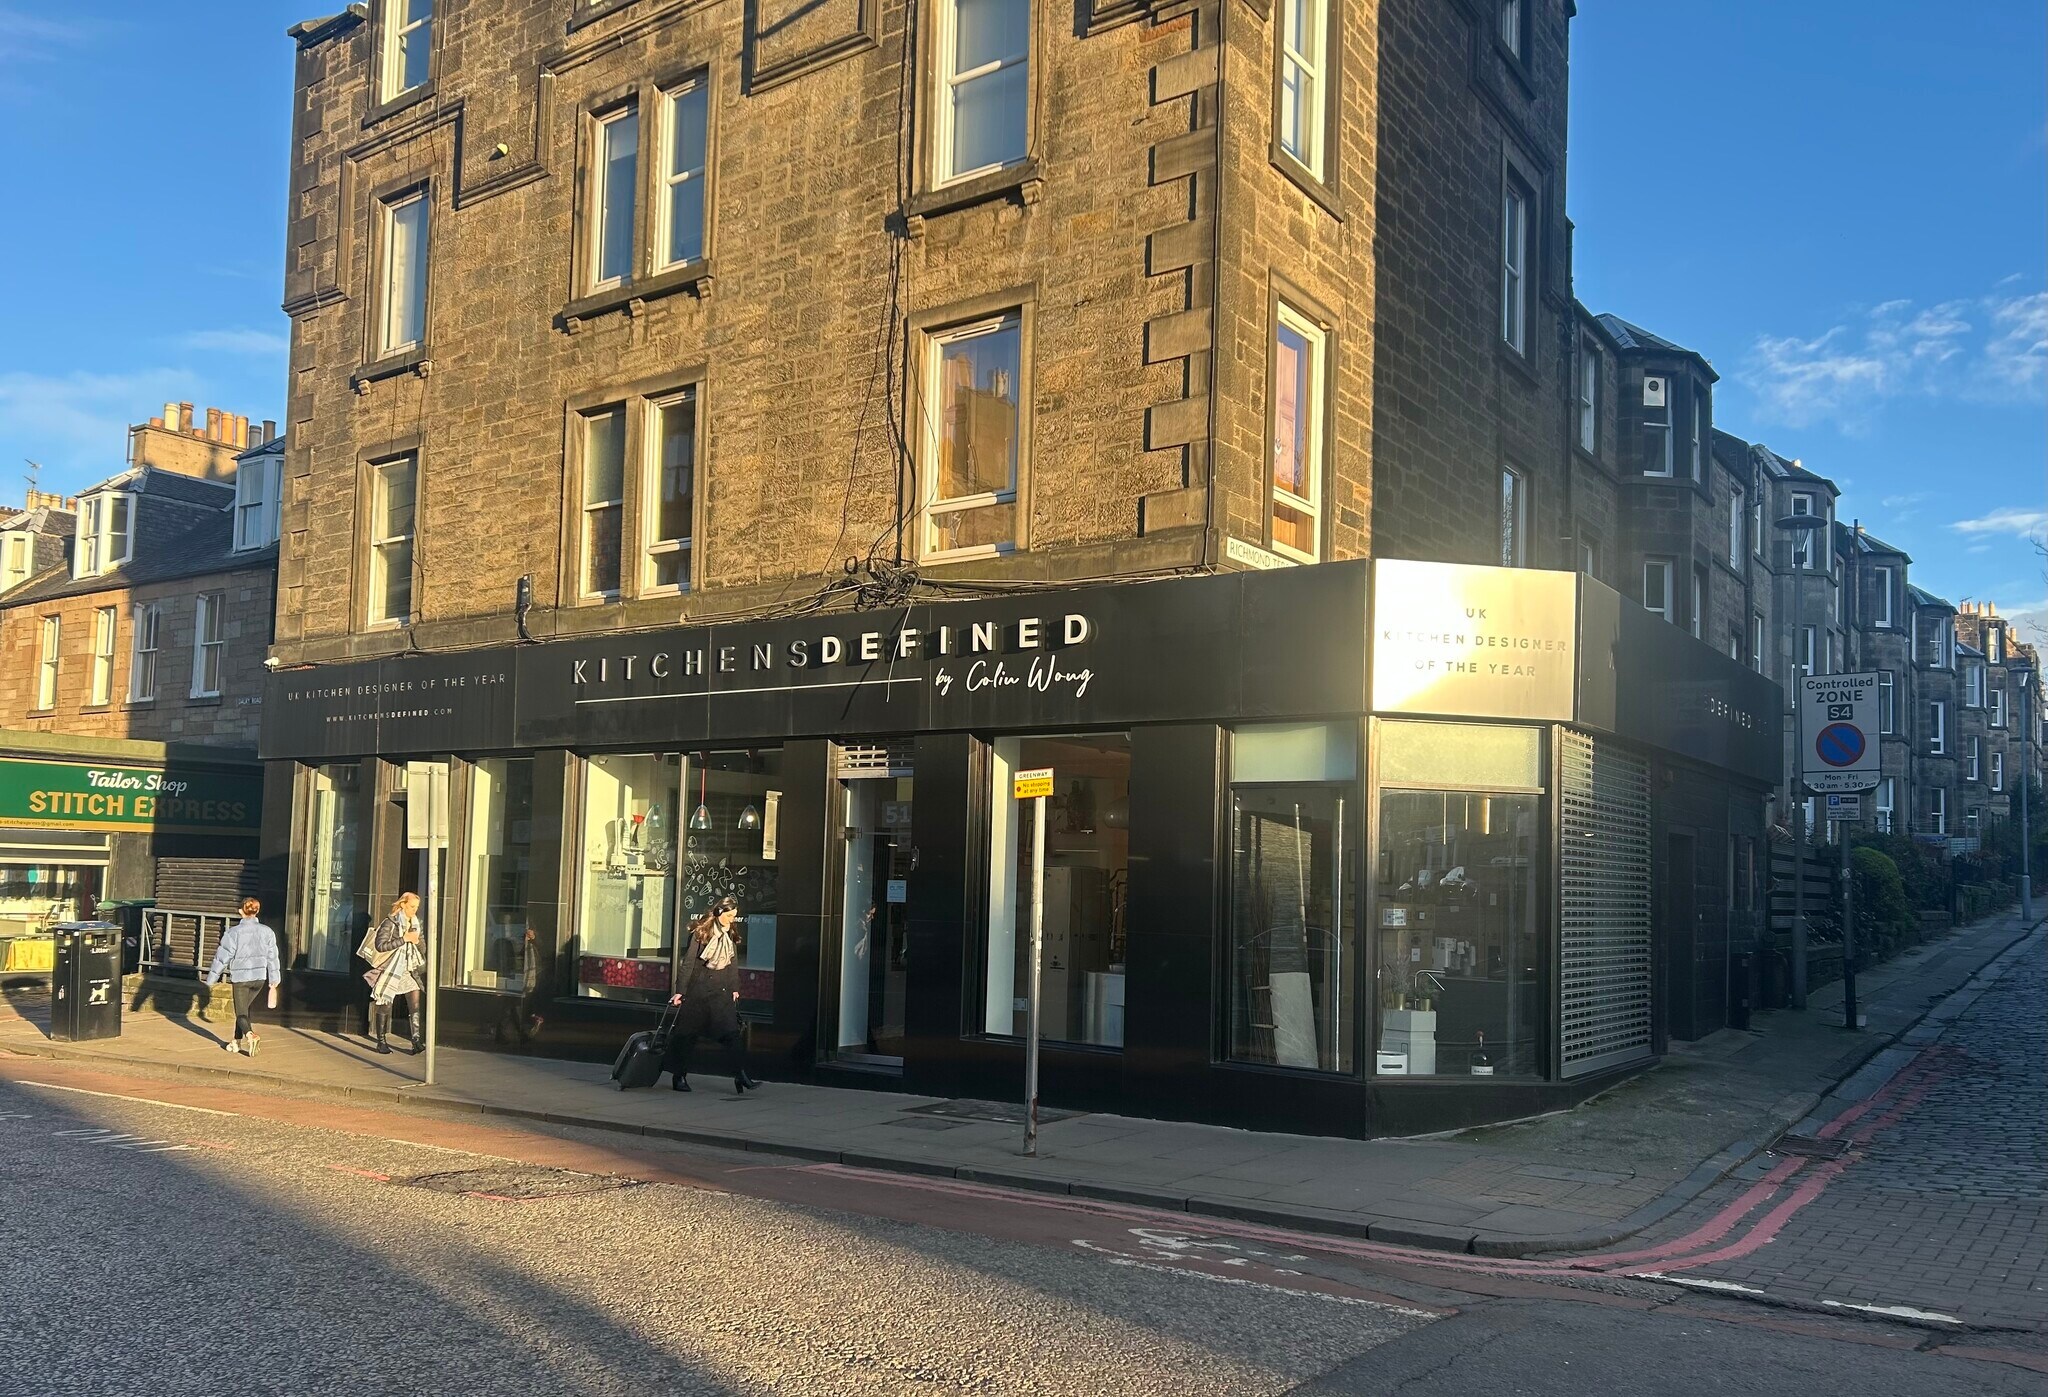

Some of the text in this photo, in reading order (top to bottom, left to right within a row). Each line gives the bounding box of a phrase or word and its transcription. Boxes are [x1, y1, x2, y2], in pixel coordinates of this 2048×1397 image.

[1230, 542, 1271, 568] RICHMOND
[1466, 607, 1487, 619] UK
[1383, 630, 1567, 652] KITCHEN DESIGNER
[935, 654, 1095, 698] by Colin Wong
[1415, 660, 1536, 677] OF THE YEAR
[288, 673, 506, 701] UK KITCHEN DESIGNER OF THE YEAR
[1806, 677, 1873, 690] Controlled
[1816, 690, 1863, 703] ZONE
[1830, 706, 1852, 719] S4
[87, 770, 188, 798] Tailor Shop
[29, 790, 247, 822] STITCH EXPRESS
